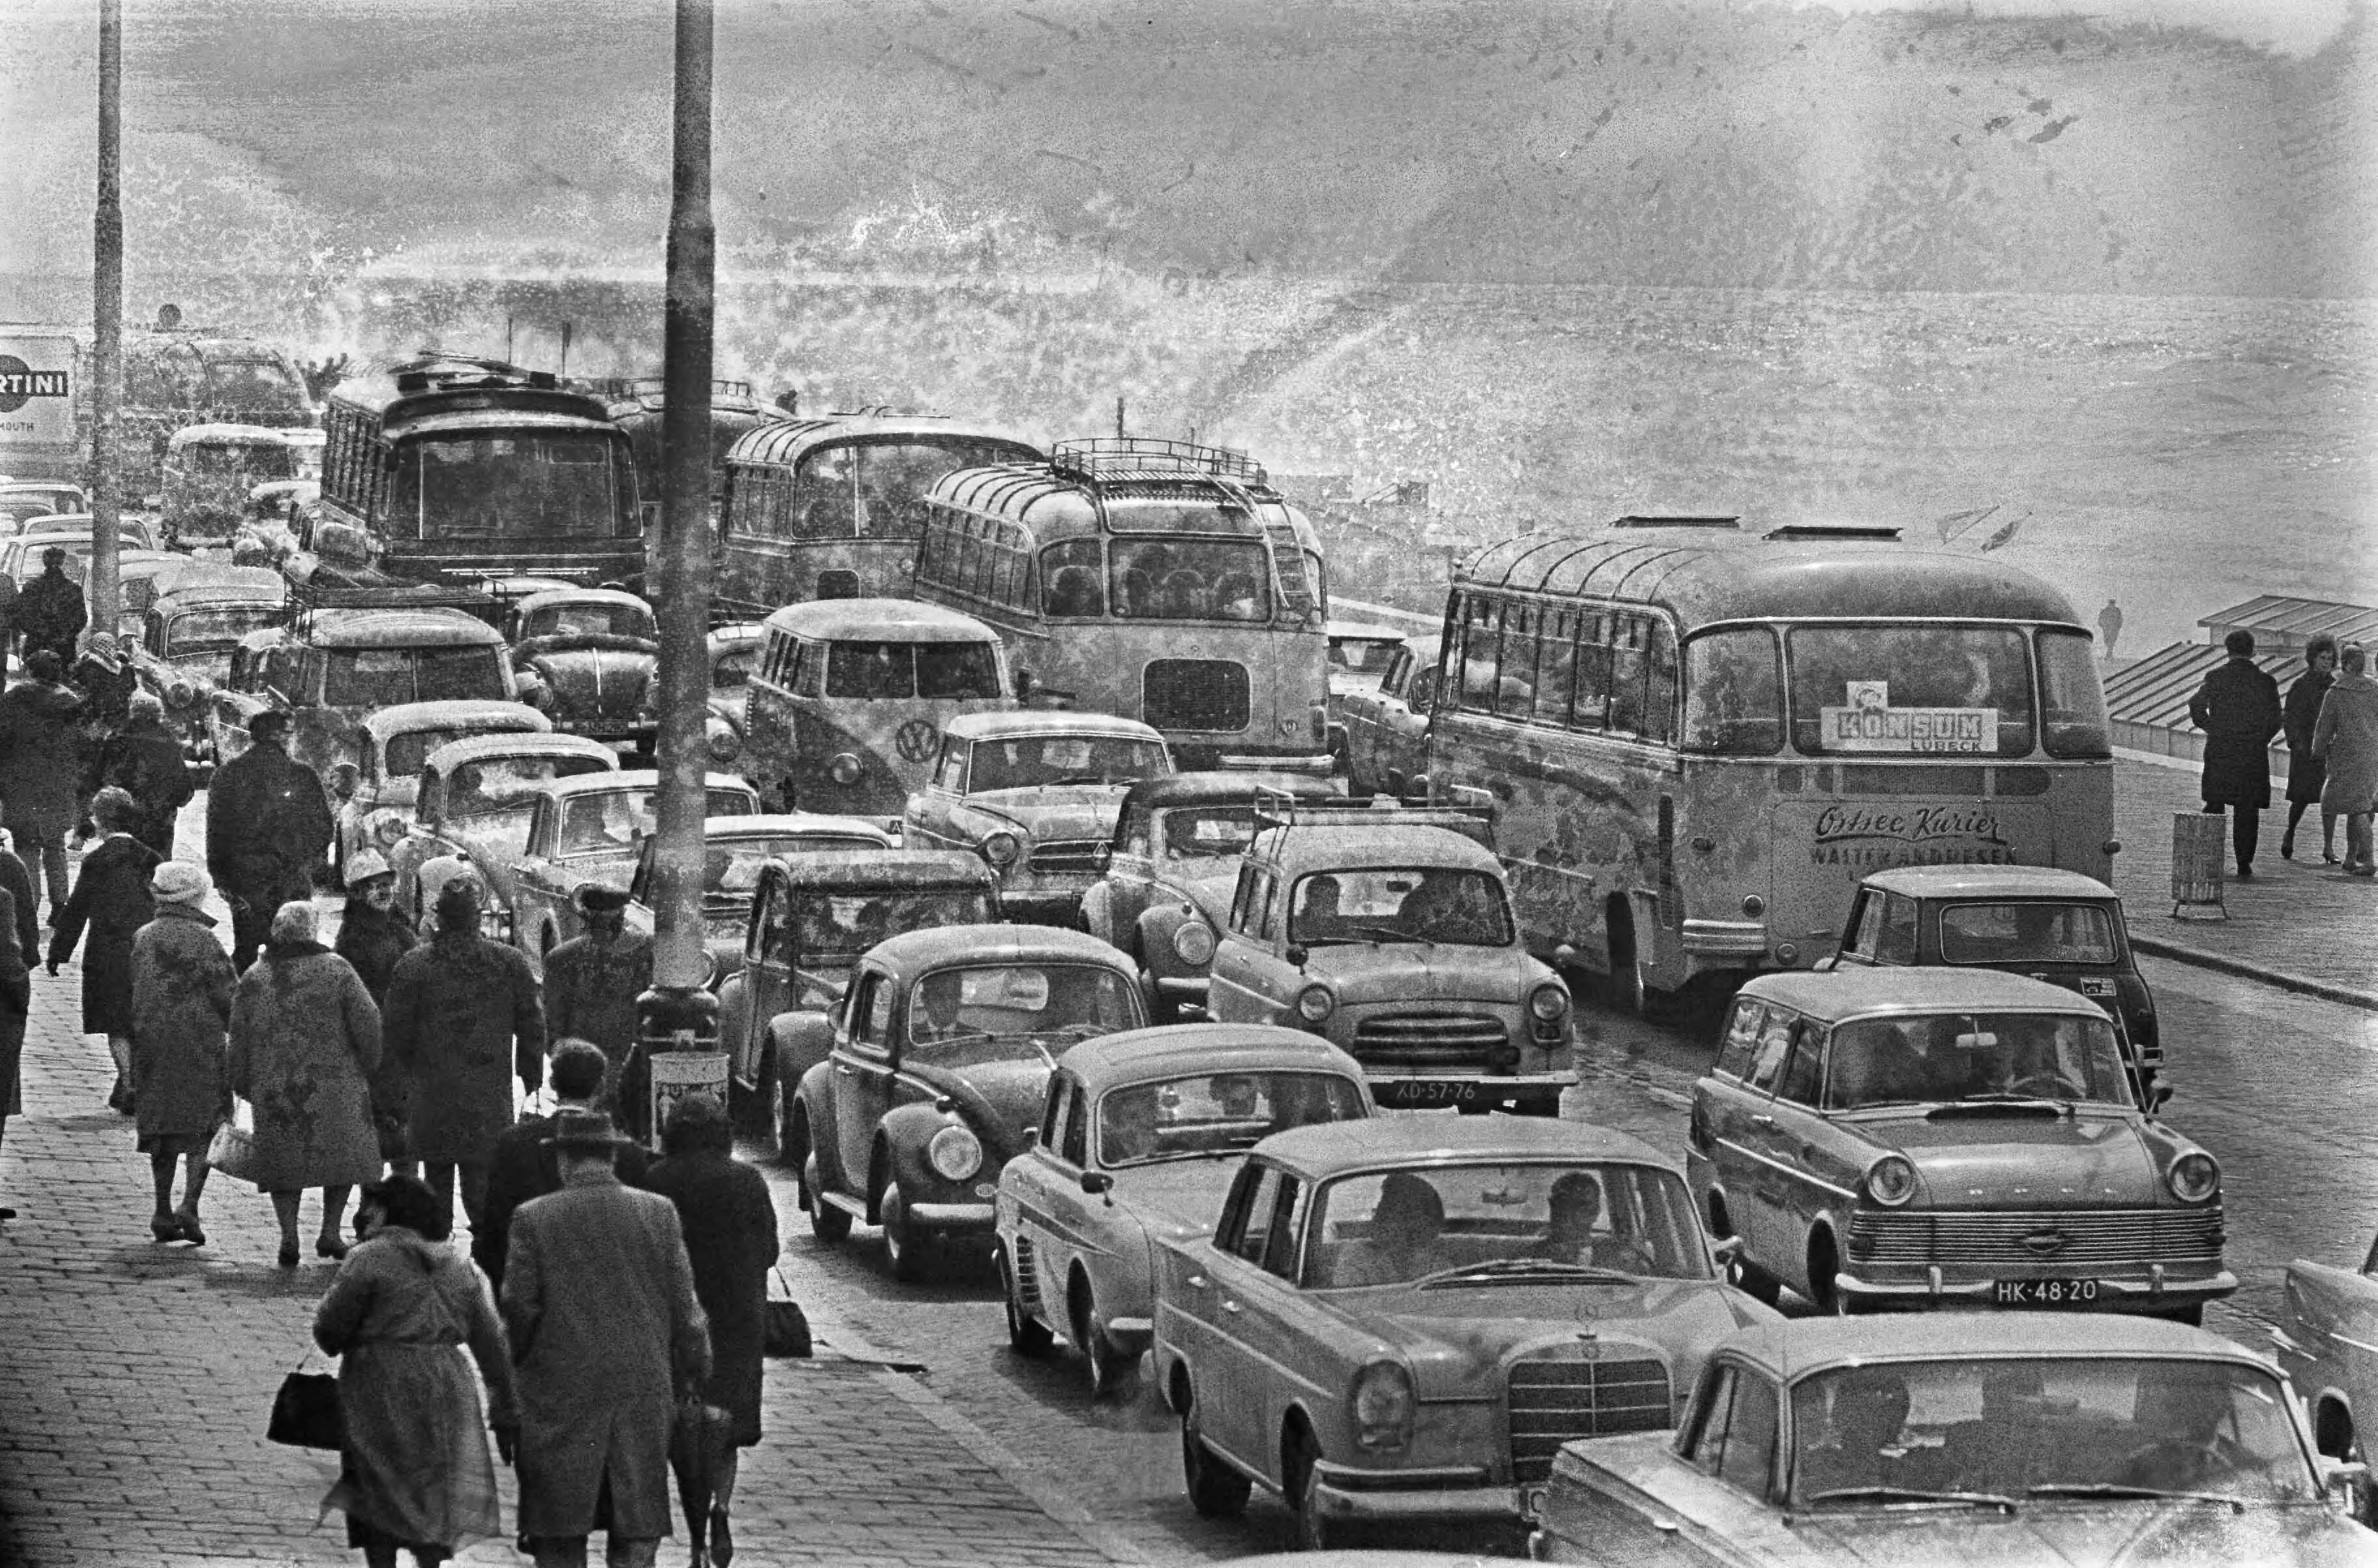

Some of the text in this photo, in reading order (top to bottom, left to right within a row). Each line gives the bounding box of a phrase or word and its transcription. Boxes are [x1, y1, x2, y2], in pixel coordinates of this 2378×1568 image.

[1838, 711, 1982, 740] KONSUM
[1912, 807, 1999, 839] Kurier
[1998, 1281, 2096, 1301] HK-48-20
